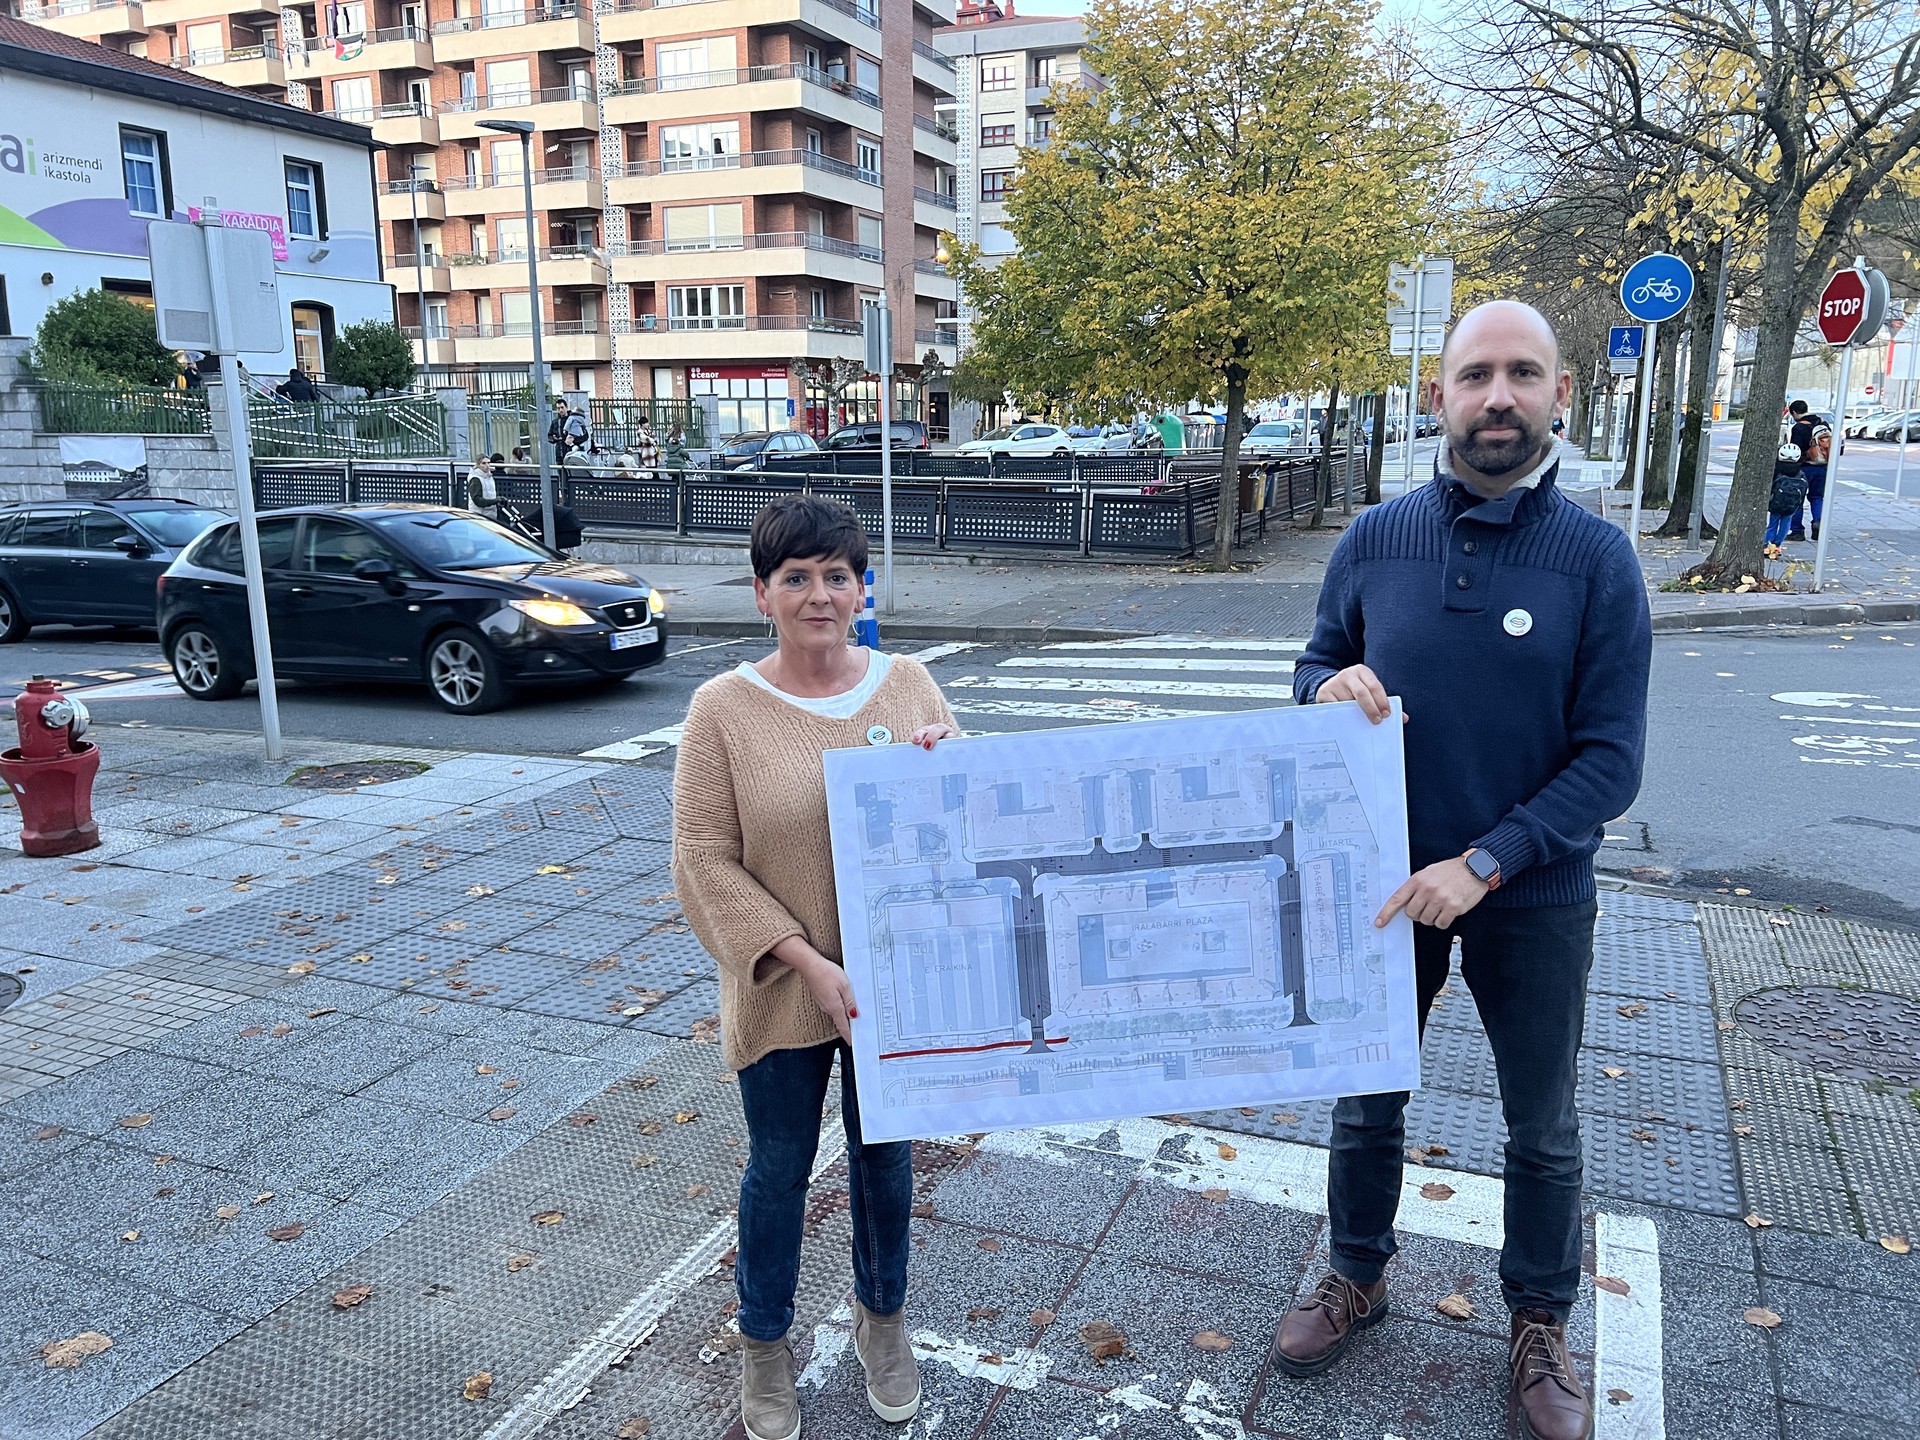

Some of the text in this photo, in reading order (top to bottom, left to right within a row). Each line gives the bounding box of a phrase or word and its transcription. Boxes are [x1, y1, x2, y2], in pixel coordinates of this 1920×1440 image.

[43, 151, 103, 171] arizmendi
[44, 165, 91, 184] ikastola
[1823, 298, 1861, 318] STOP
[697, 371, 720, 379] cenor
[1133, 916, 1214, 931] IRALABARRI PLAZA
[934, 963, 973, 973] ERAIKINA
